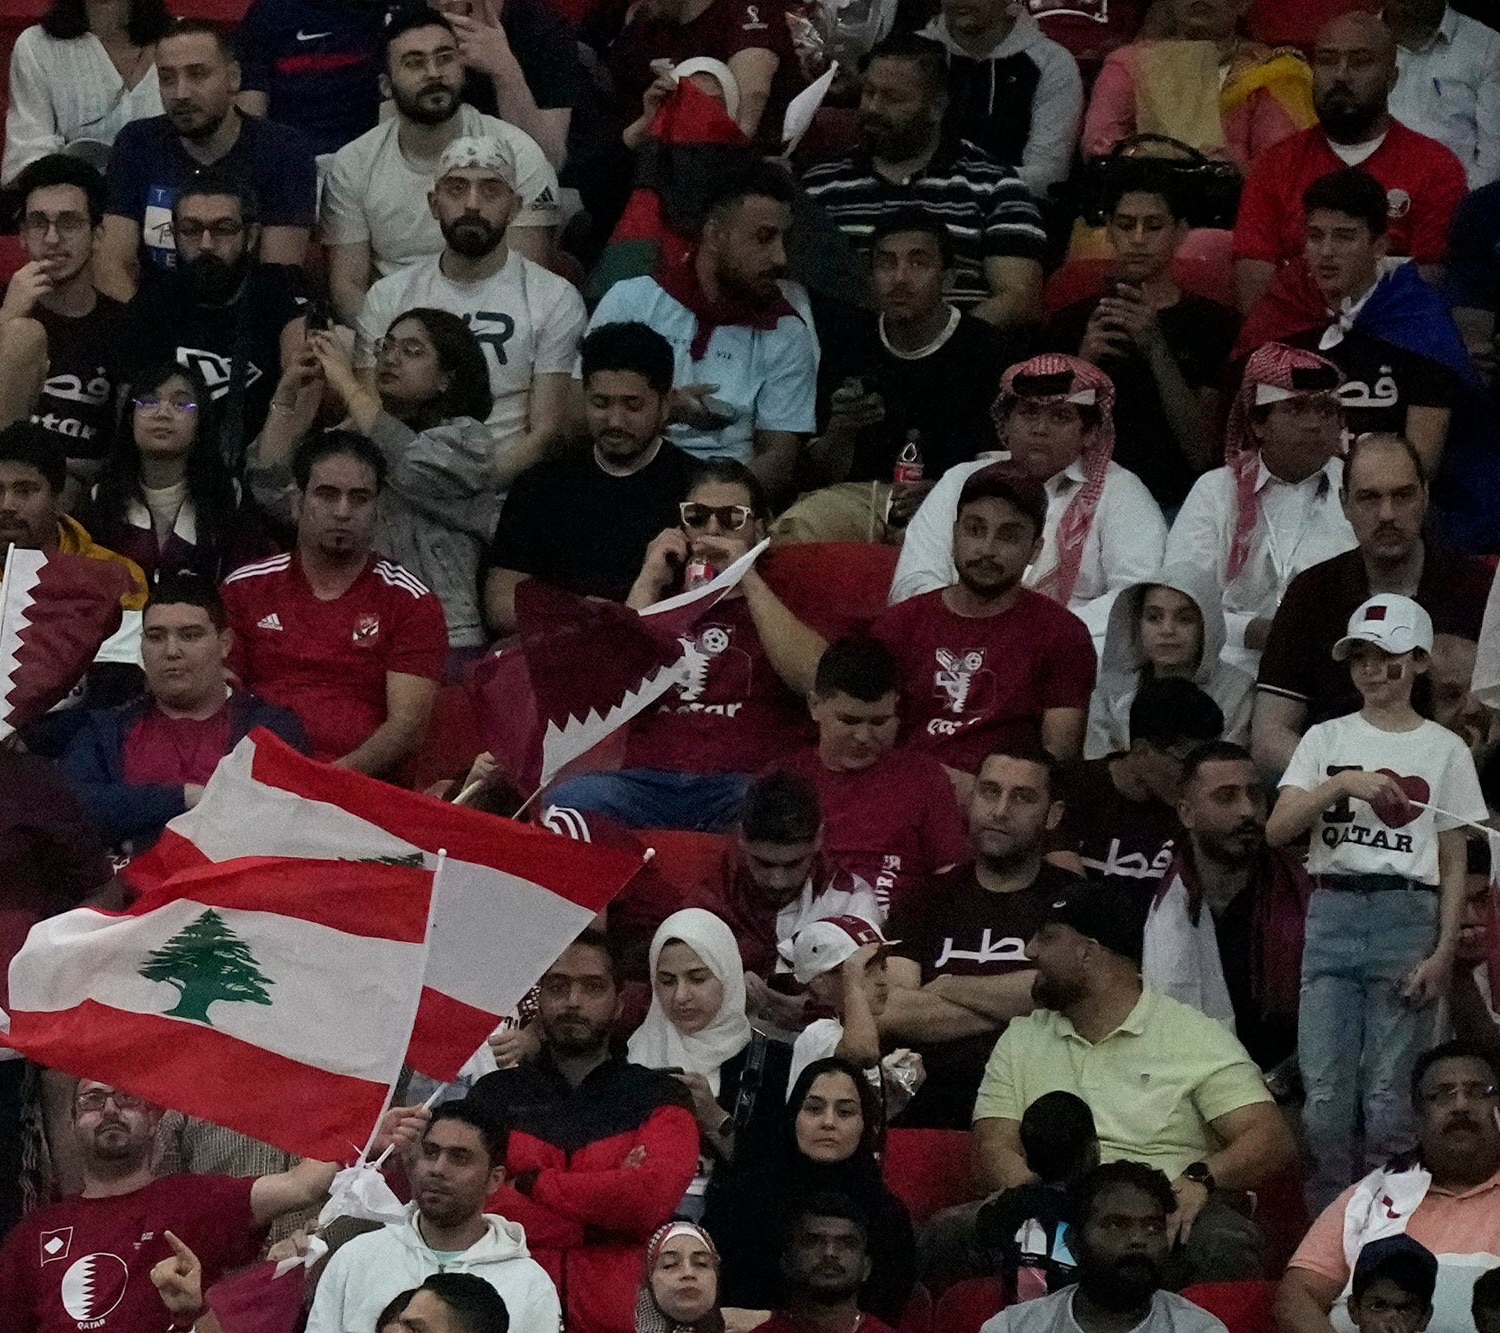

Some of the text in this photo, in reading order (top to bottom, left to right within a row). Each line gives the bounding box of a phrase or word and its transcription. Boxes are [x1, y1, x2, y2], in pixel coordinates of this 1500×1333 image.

[1322, 826, 1413, 852] QATAR
[935, 929, 1029, 967] طر
[77, 1318, 106, 1331] QATAR
